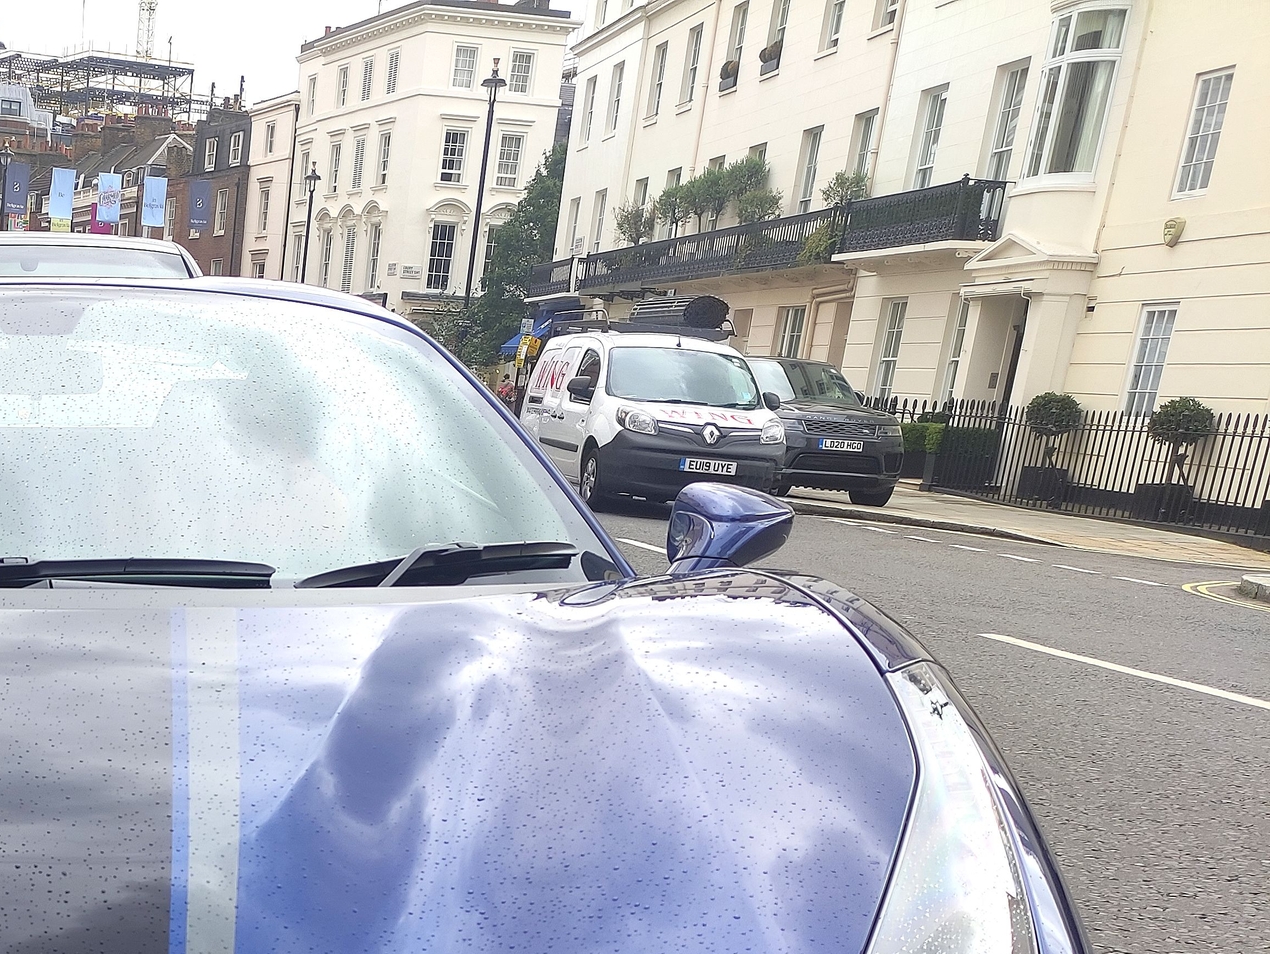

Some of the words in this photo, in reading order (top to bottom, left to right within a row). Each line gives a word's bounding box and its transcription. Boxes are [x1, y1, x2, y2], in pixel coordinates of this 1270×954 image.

[534, 360, 570, 392] WING
[660, 408, 754, 425] WING
[824, 441, 845, 449] LD20
[688, 460, 711, 472] EU19
[712, 462, 734, 474] UYE
